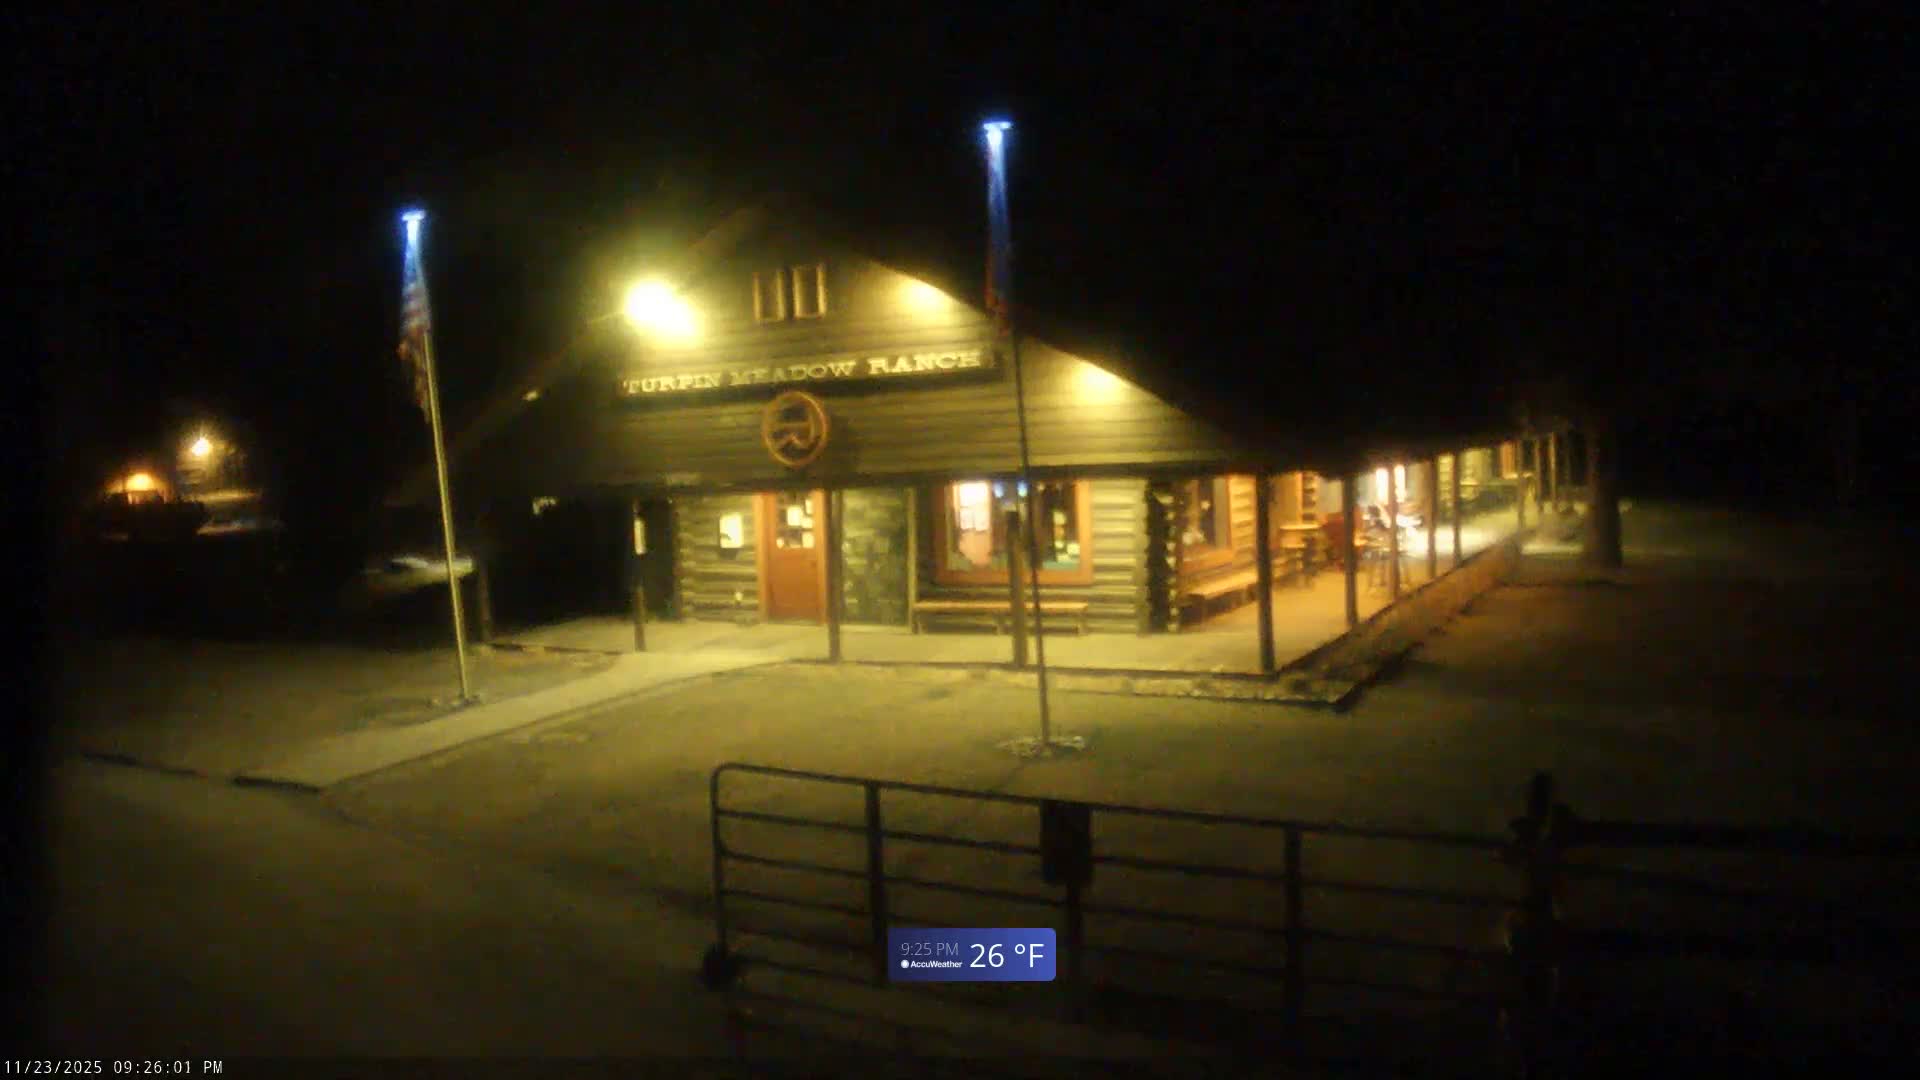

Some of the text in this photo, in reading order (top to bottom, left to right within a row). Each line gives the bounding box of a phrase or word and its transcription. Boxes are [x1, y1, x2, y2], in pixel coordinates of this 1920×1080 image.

[624, 351, 981, 395] TURPIN MEADOW RANCH
